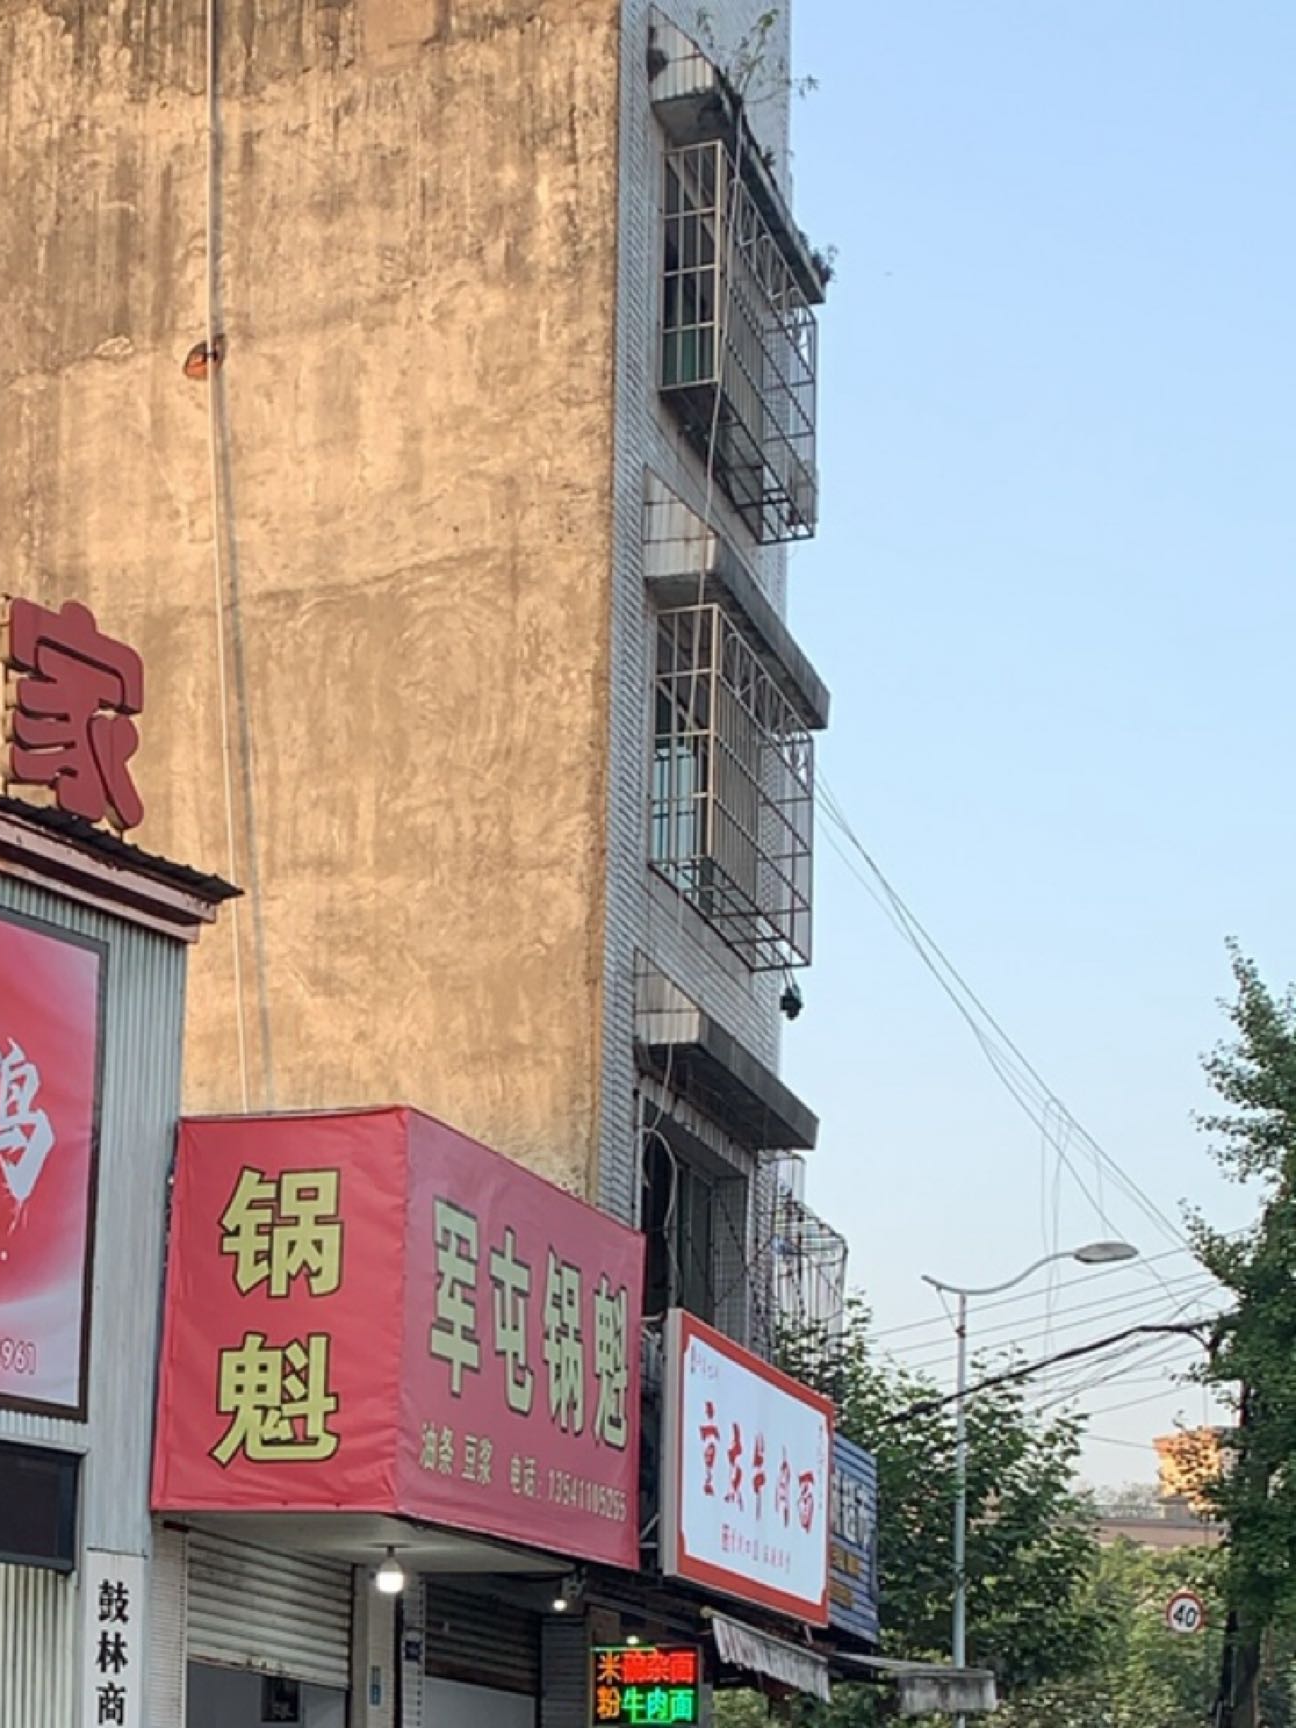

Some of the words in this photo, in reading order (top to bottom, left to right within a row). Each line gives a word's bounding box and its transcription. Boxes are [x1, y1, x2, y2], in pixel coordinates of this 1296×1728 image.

[209, 1165, 344, 1469] 锅魁
[428, 1195, 628, 1449] 军屯锅魁
[1173, 1604, 1197, 1628] 40
[621, 1686, 694, 1722] 牛肉面
